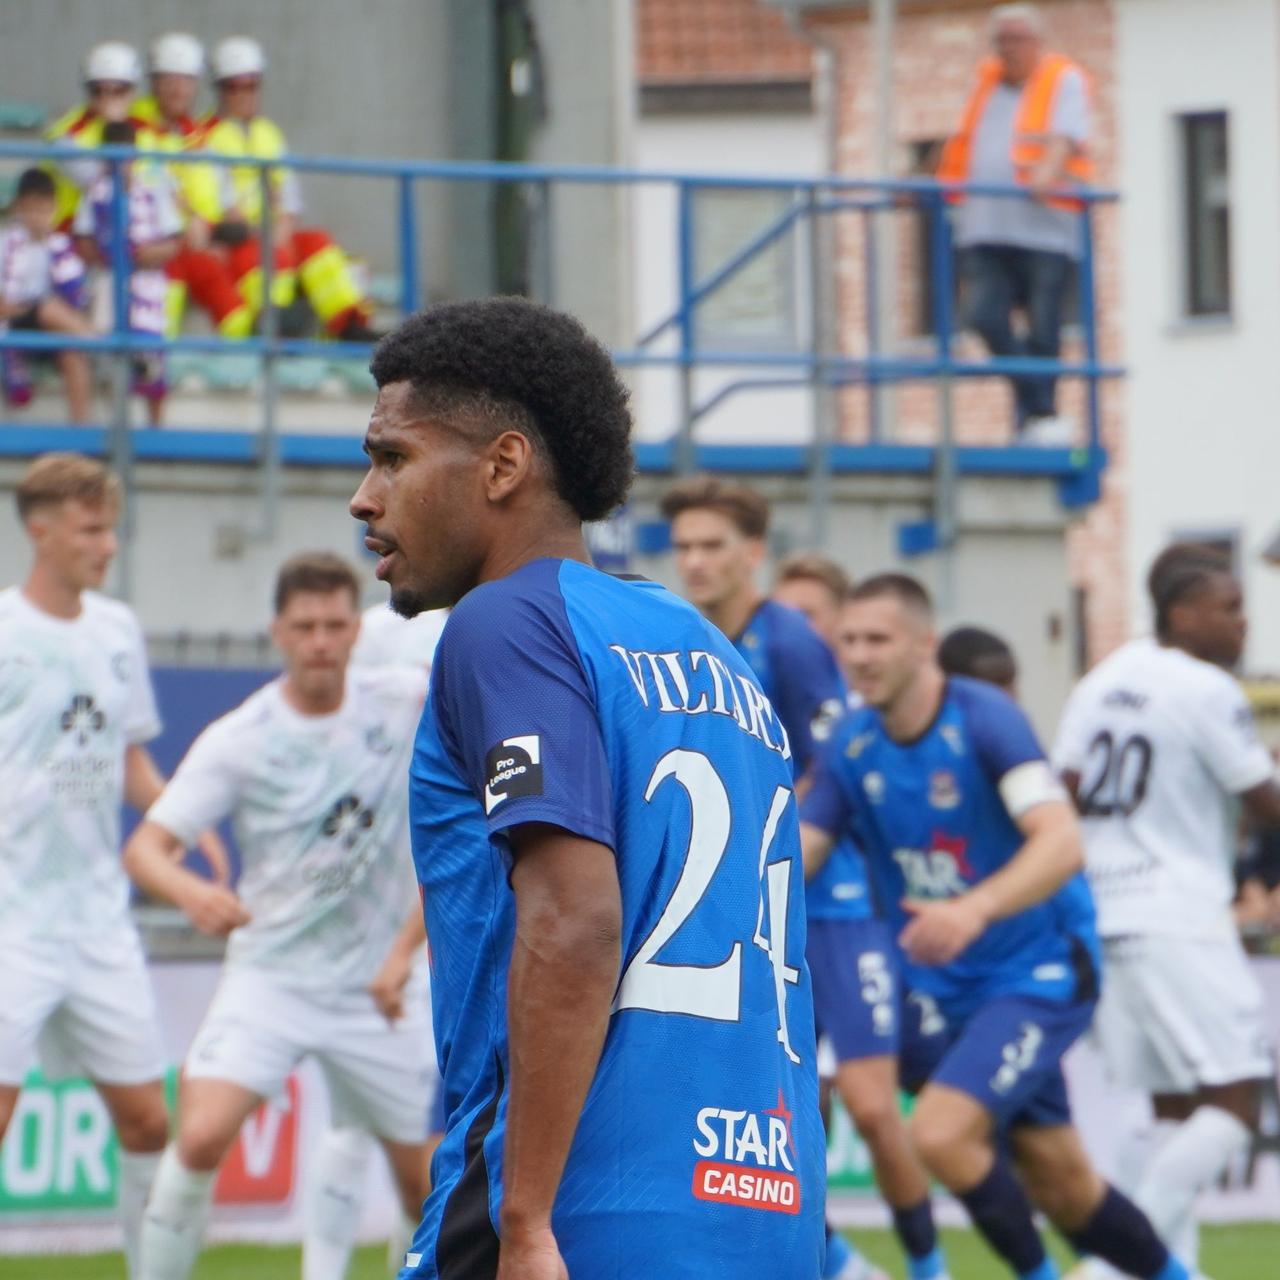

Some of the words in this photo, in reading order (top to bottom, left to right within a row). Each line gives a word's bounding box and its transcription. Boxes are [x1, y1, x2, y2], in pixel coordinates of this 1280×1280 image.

[489, 765, 527, 788] League
[496, 757, 515, 772] Pro
[1079, 728, 1153, 818] 20
[609, 747, 801, 1065] 24
[693, 1107, 794, 1172] STAR
[703, 1169, 795, 1207] CASINO
